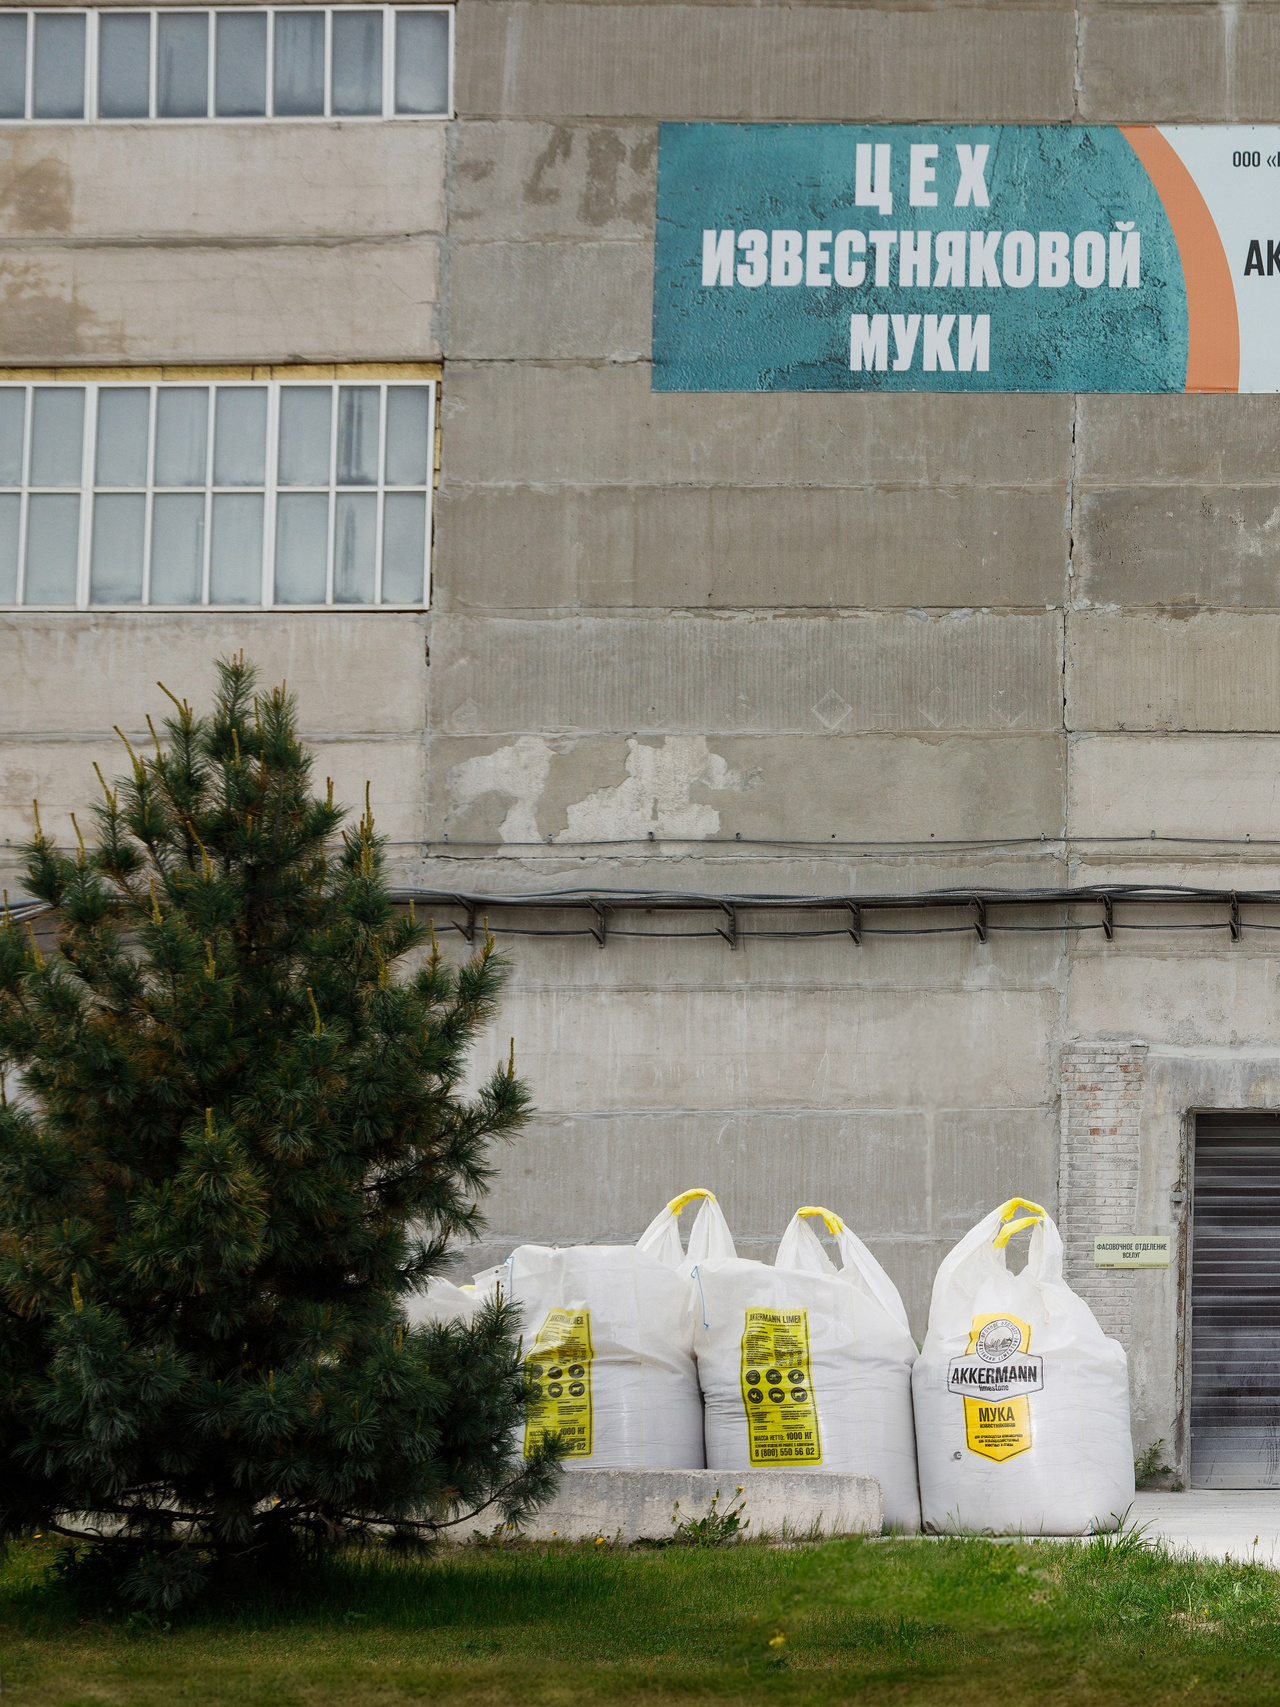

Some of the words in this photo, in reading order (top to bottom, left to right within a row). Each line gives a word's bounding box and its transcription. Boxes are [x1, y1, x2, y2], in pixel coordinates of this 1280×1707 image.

[1232, 151, 1261, 168] ООО
[855, 143, 990, 214] ЦЕХ
[702, 221, 1141, 288] ИЗВЕСТНЯКОВОЙ
[850, 314, 990, 371] МУКИ
[1096, 1243, 1133, 1251] ФАСОВОЧНОЕ
[1134, 1243, 1167, 1251] ОТДЕЛЕНИЕ
[951, 1365, 1038, 1384] AKKERMANN
[979, 1383, 1009, 1392] limestone
[978, 1406, 1015, 1422] МУКА
[786, 1431, 803, 1440] 1000
[804, 1431, 814, 1440] КГ
[754, 1448, 760, 1457] 8
[760, 1448, 778, 1458] (800)
[779, 1447, 793, 1456] 550
[794, 1447, 804, 1456] 56
[805, 1447, 815, 1456] 02
